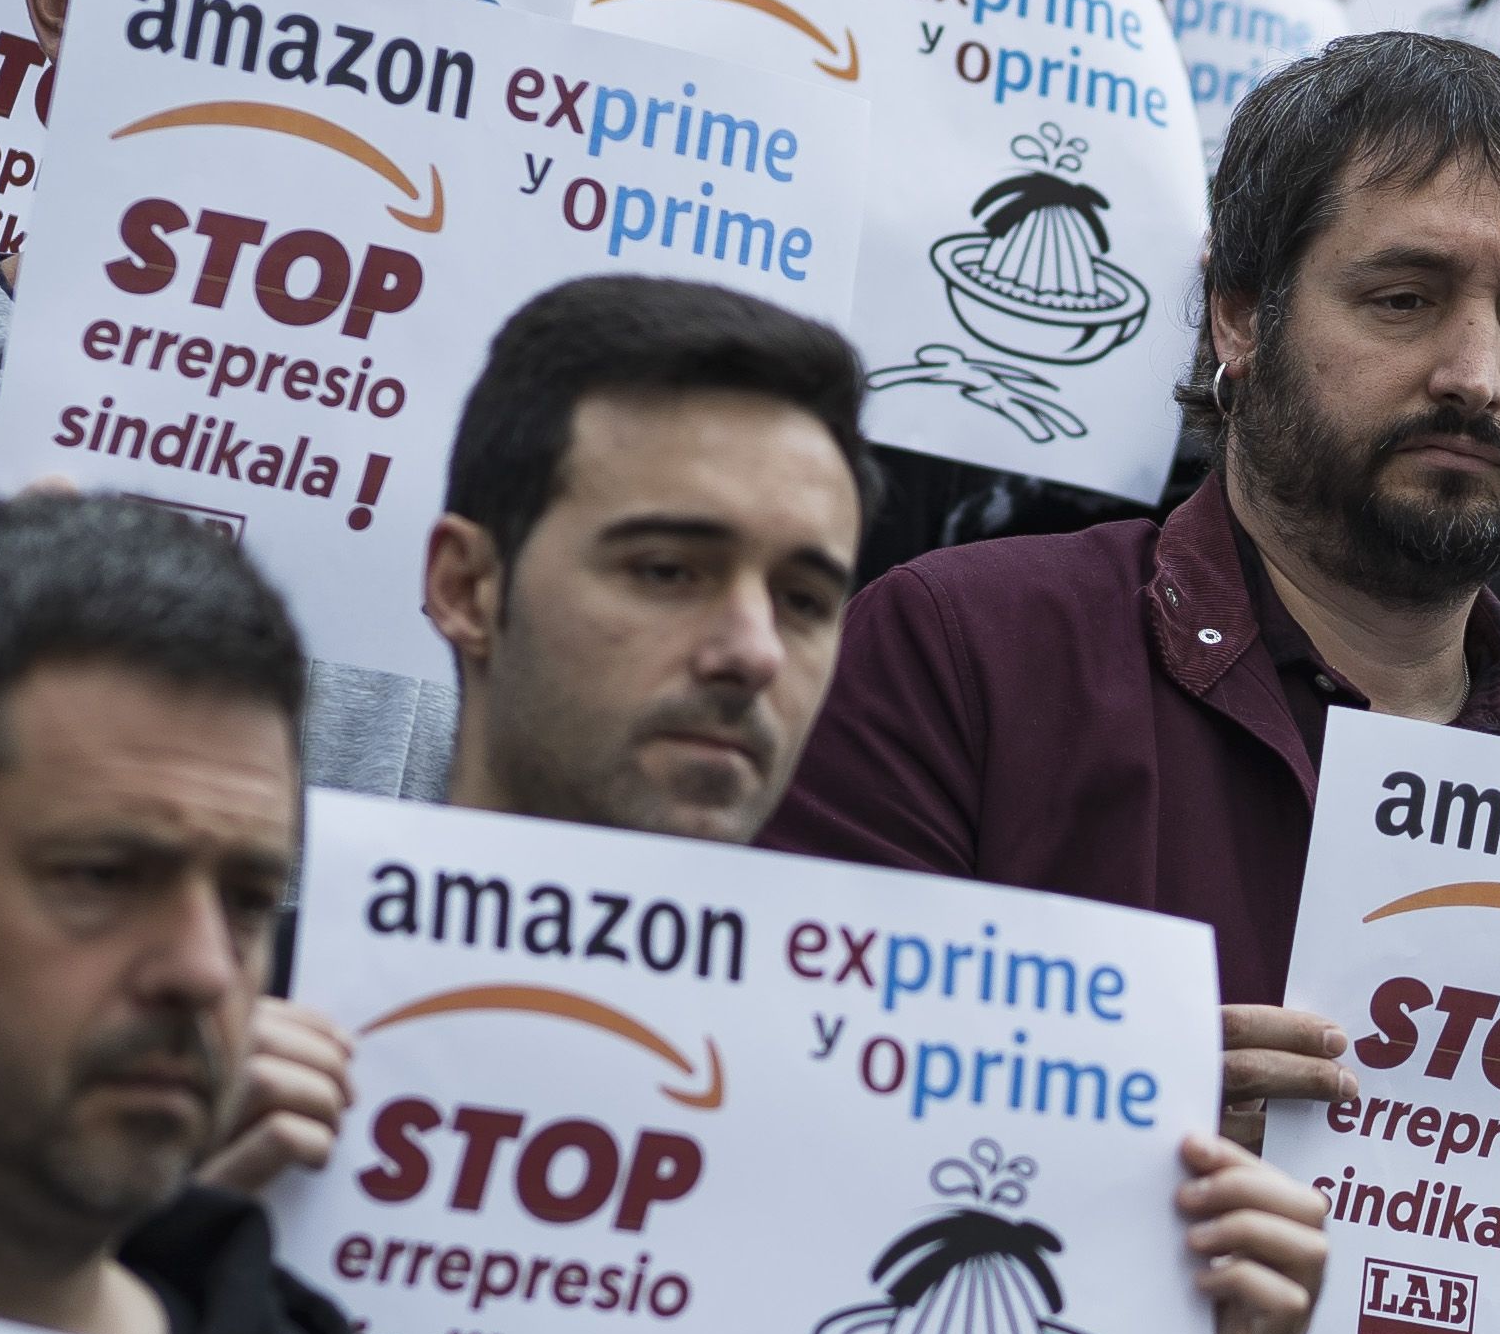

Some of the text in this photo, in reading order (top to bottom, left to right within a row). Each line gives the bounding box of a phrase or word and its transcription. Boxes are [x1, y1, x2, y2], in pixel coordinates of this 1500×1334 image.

[505, 66, 799, 184] exprime
[918, 21, 945, 55] y
[954, 38, 1169, 128] oprime
[104, 197, 426, 339] STOP
[518, 150, 815, 282] y oprime
[84, 317, 408, 418] errepresio
[363, 861, 1124, 1017] amazon exprime
[808, 1007, 1155, 1126] y oprime
[354, 1097, 703, 1233] STOP
[334, 1233, 691, 1319] errepresio
[1365, 1265, 1474, 1327] LAB
